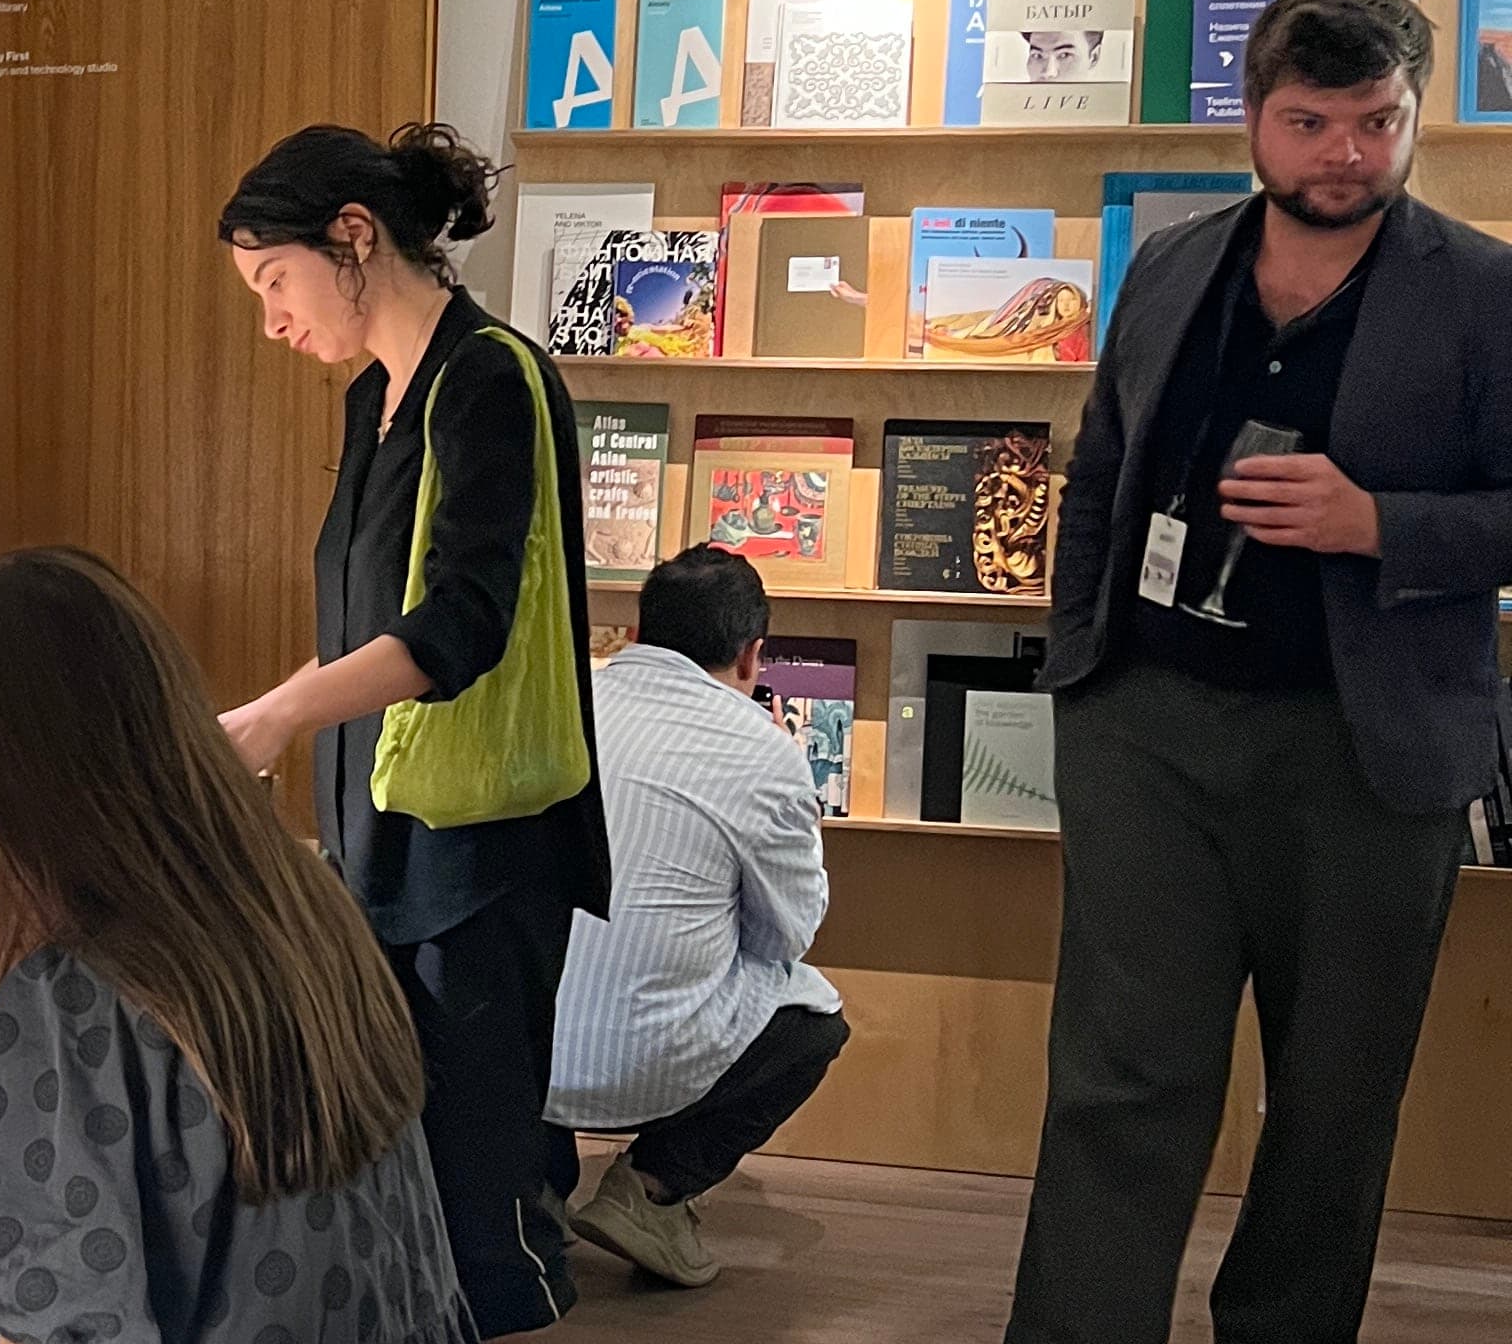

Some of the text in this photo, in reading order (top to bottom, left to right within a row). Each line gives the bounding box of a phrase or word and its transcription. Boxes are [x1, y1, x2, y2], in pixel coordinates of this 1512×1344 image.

[1025, 4, 1093, 20] БАТЫР
[6, 51, 30, 61] First
[10, 66, 29, 75] and
[30, 64, 85, 76] technology
[87, 63, 118, 74] studio
[955, 217, 966, 228] di
[969, 218, 1006, 229] niente
[593, 415, 626, 431] Atlas
[592, 433, 658, 449] of Central
[591, 450, 627, 466] Asian
[590, 468, 638, 485] artistic
[589, 486, 628, 502] crafts
[588, 502, 611, 519] and
